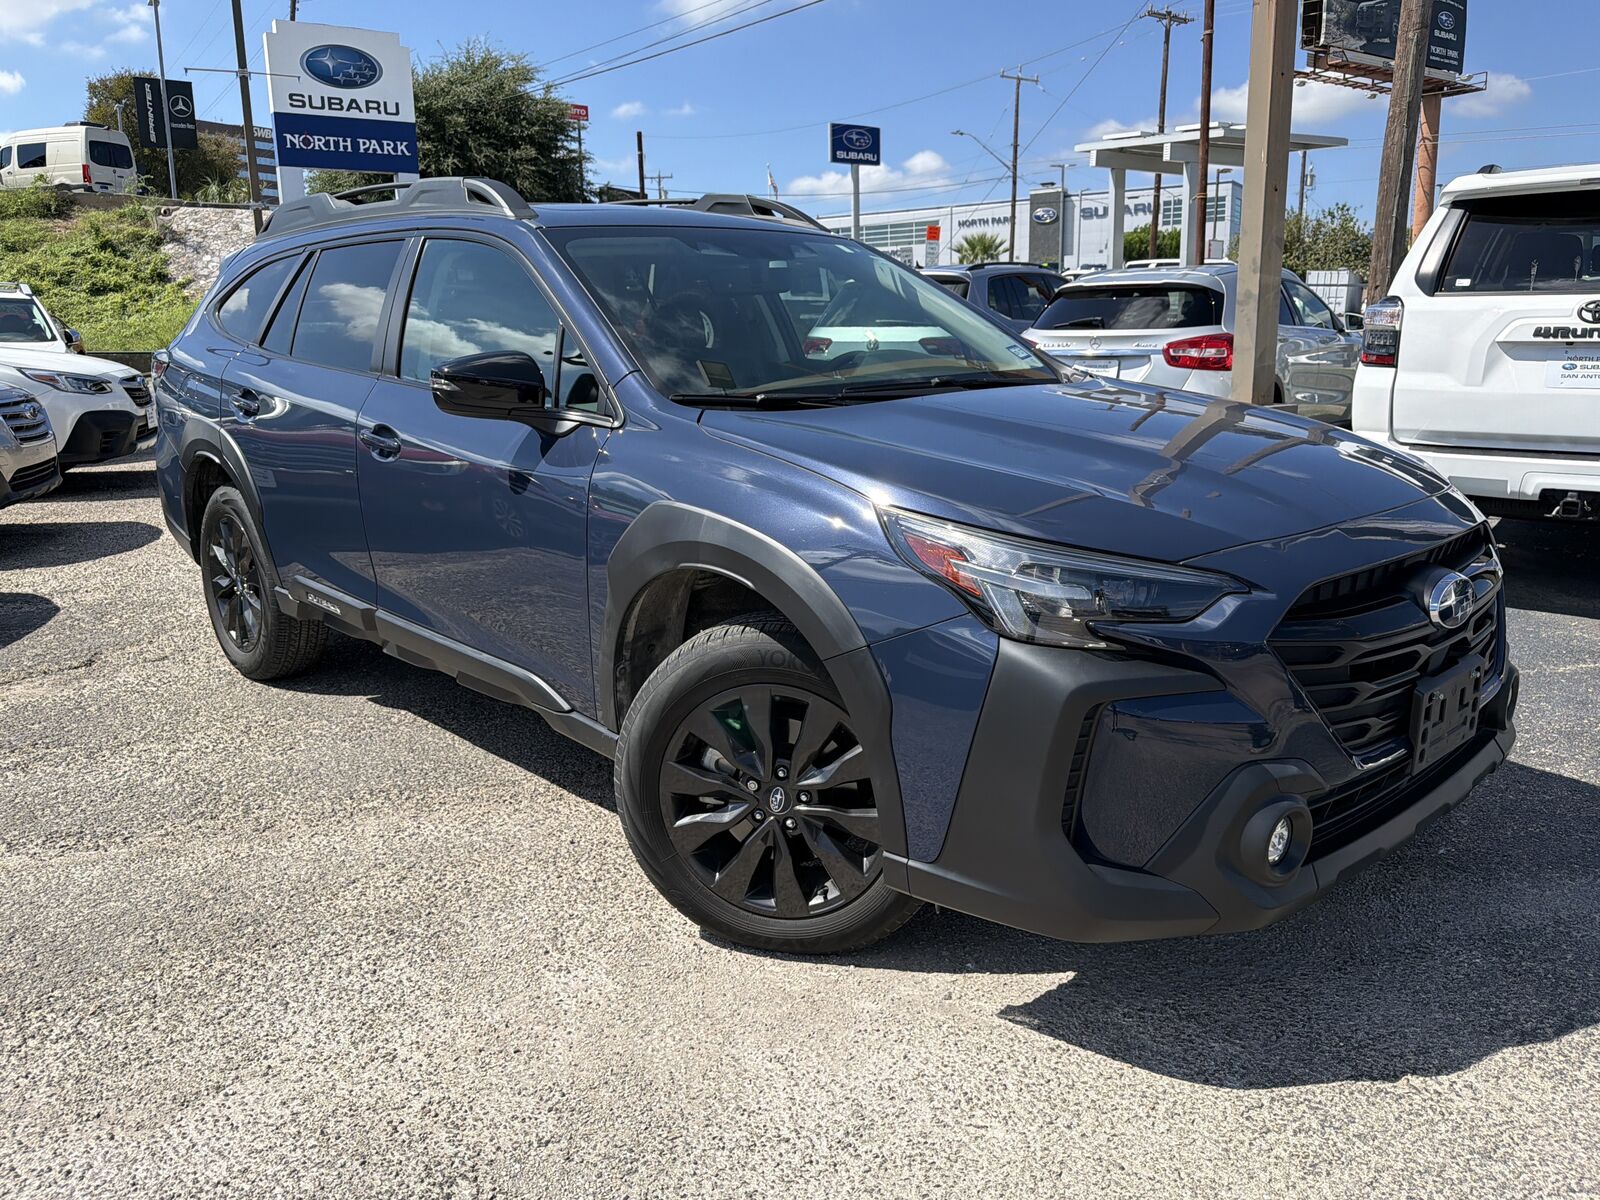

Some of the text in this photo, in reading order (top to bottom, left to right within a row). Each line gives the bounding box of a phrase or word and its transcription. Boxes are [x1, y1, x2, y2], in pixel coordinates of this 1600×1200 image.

[1434, 29, 1457, 41] SUBARU
[144, 83, 157, 143] SPRINTER
[288, 93, 400, 116] SUBARU
[283, 132, 412, 156] NORTH PARK
[836, 151, 877, 161] SUBARU
[1081, 203, 1154, 220] SUAR
[958, 213, 1012, 228] NORTH PAR
